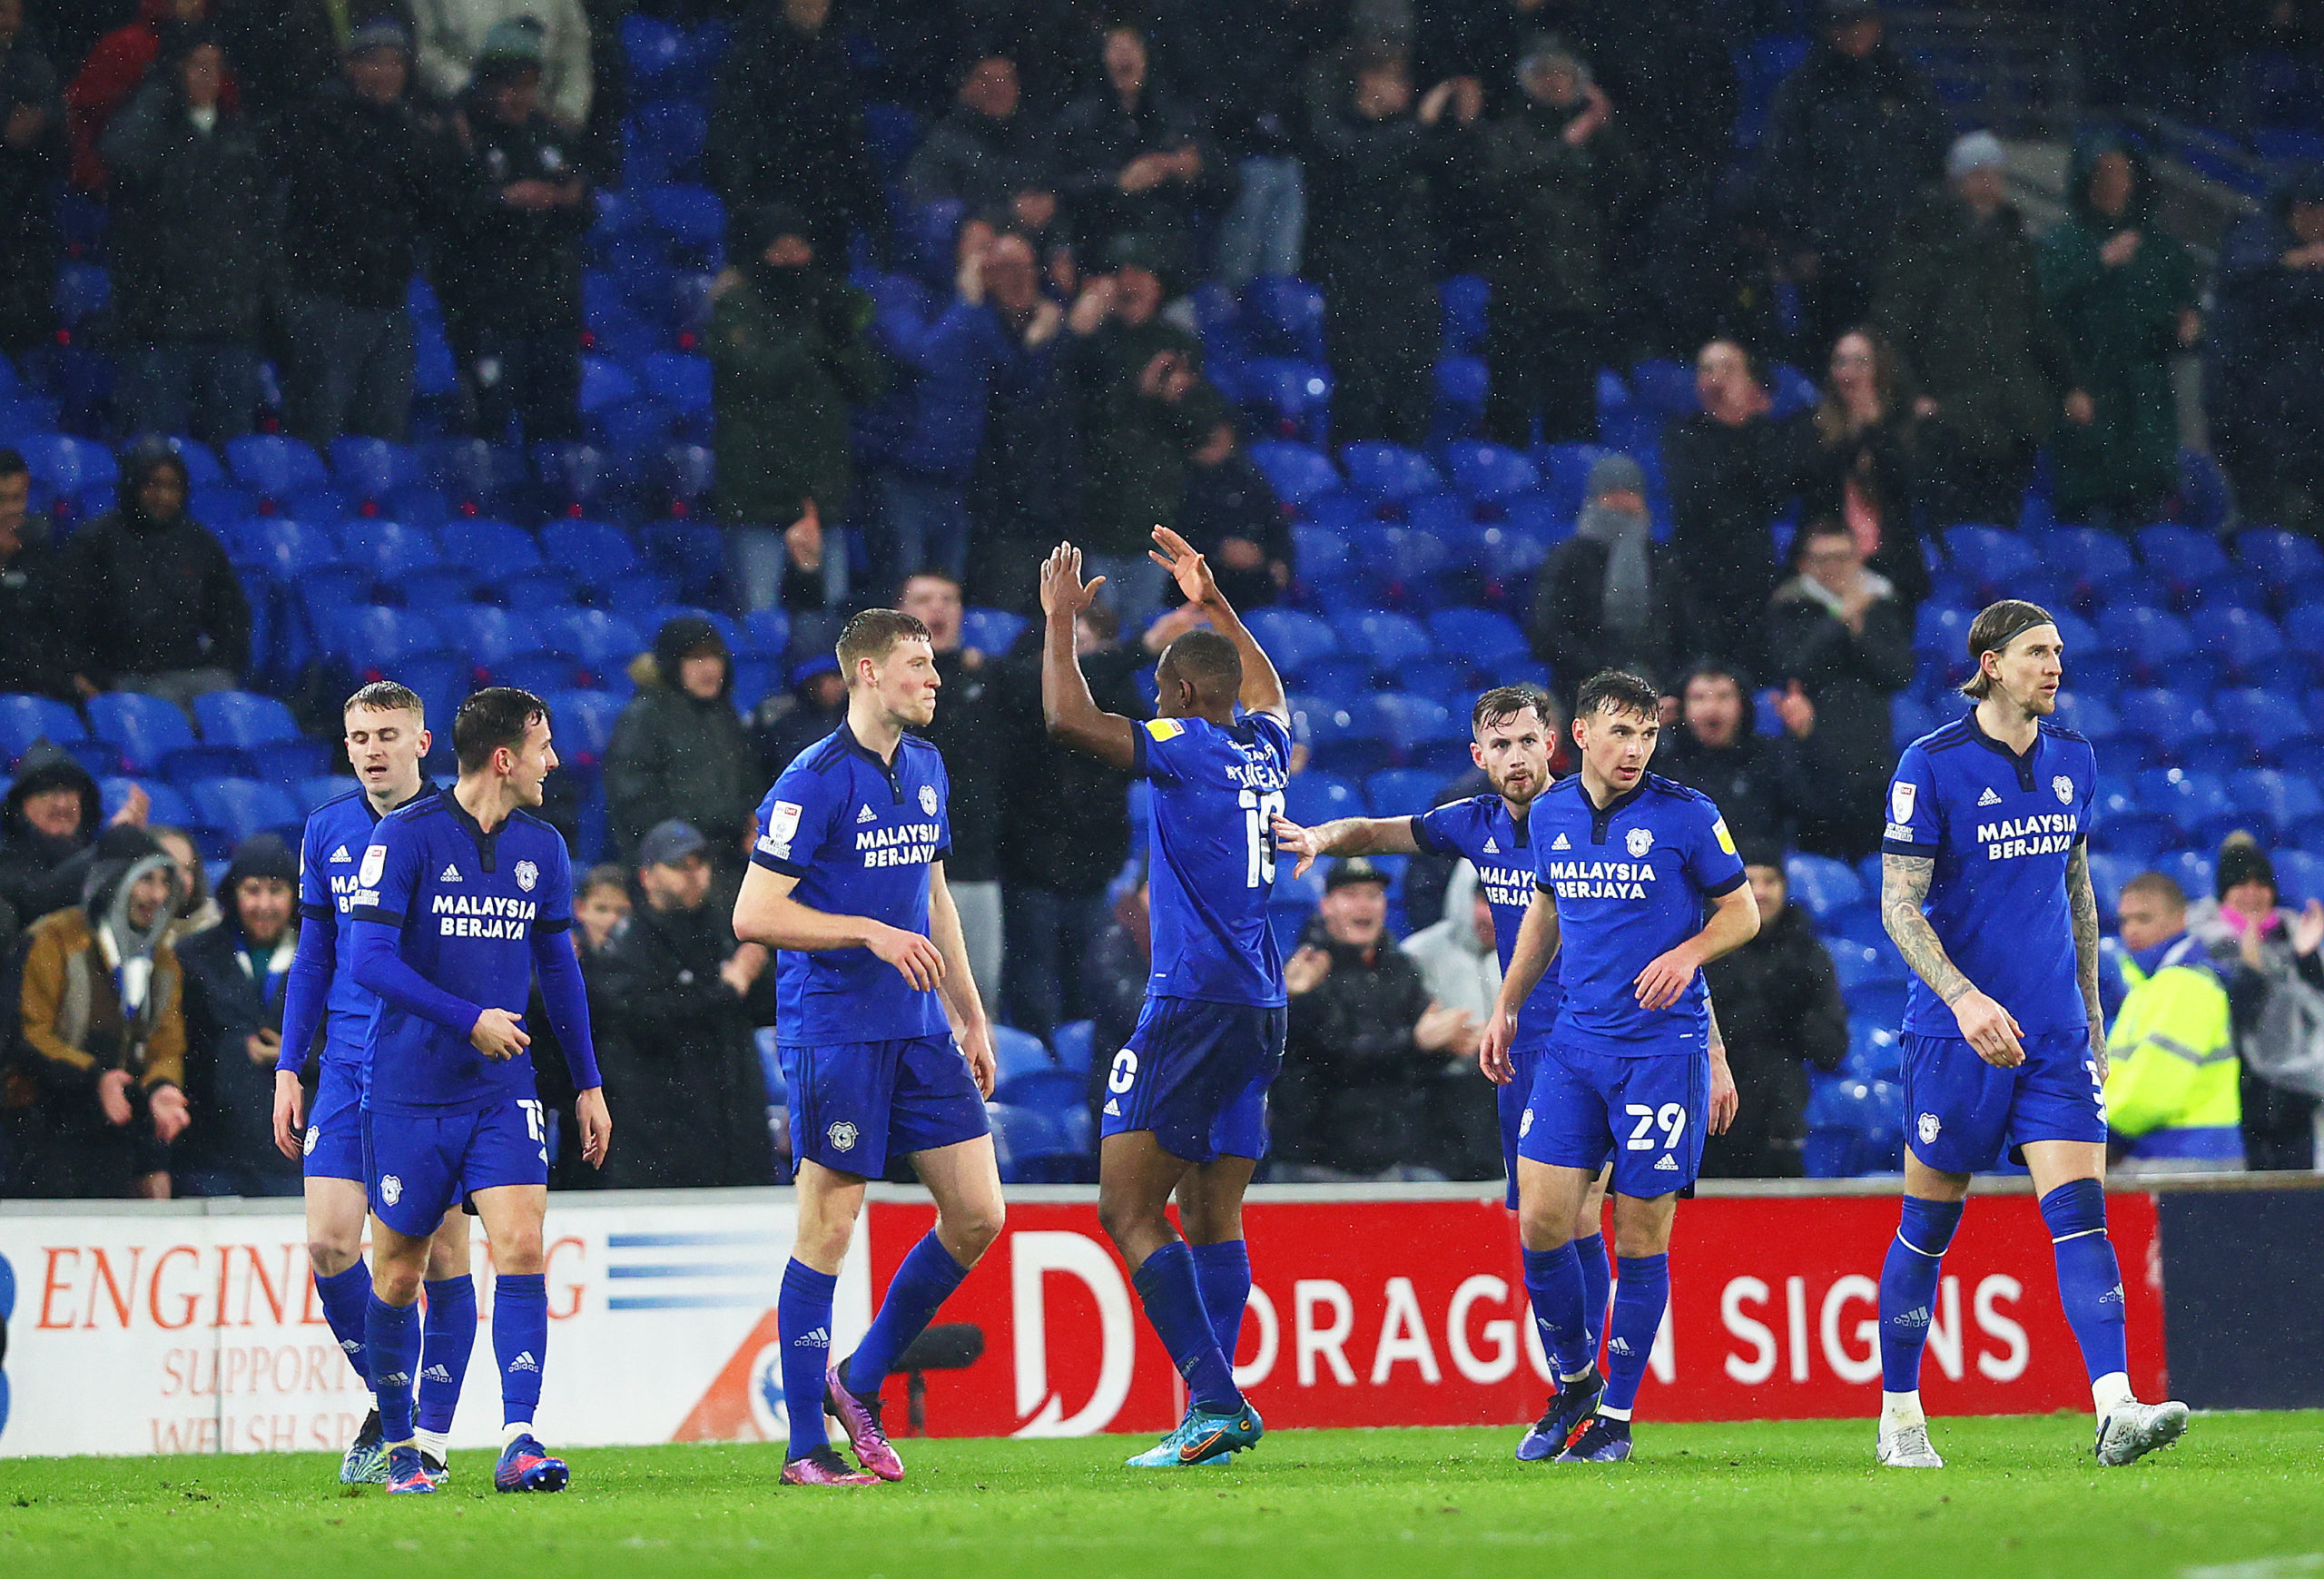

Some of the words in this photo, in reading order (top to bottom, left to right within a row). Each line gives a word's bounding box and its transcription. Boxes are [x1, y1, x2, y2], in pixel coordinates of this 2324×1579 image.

[1977, 814, 2077, 844] MALAYSIA
[1988, 834, 2071, 861] BERJAYA
[1550, 861, 1657, 882] MALAYSIA
[1556, 881, 1647, 899] BERJAYA
[431, 894, 537, 921] MALAYSIA
[439, 917, 525, 940] BERJAYA
[1625, 1102, 1687, 1150] 29
[1720, 1273, 2031, 1386] SIGNS
[507, 1362, 539, 1374] adidas
